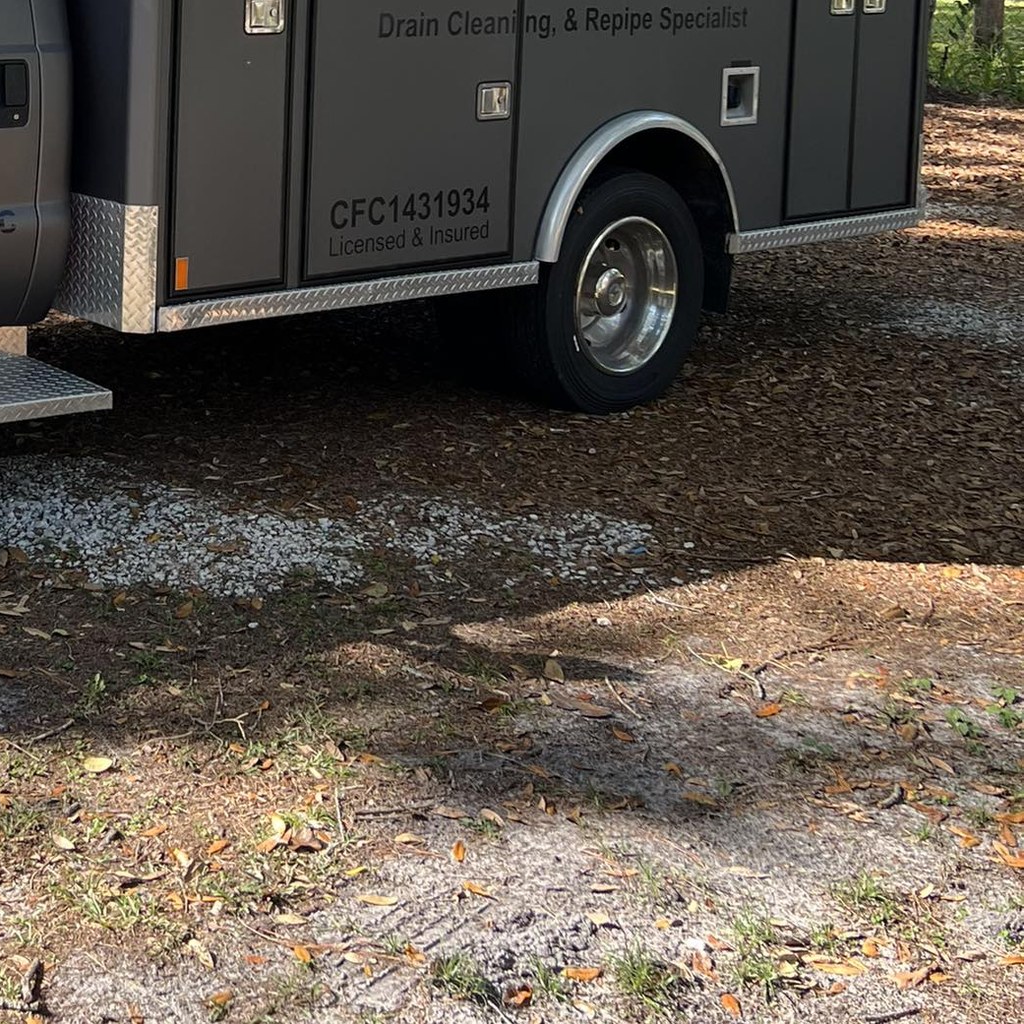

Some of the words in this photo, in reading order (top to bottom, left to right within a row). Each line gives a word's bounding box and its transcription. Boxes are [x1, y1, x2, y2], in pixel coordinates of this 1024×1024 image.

[378, 11, 439, 39] Drain
[447, 7, 557, 38] Cleaning,
[563, 7, 578, 32] &
[585, 6, 653, 37] Repipe
[659, 5, 749, 31] Specialist
[330, 185, 490, 230] CFC1431934
[329, 229, 406, 257] Licensed
[411, 226, 424, 248] &
[430, 219, 490, 246] Insured
